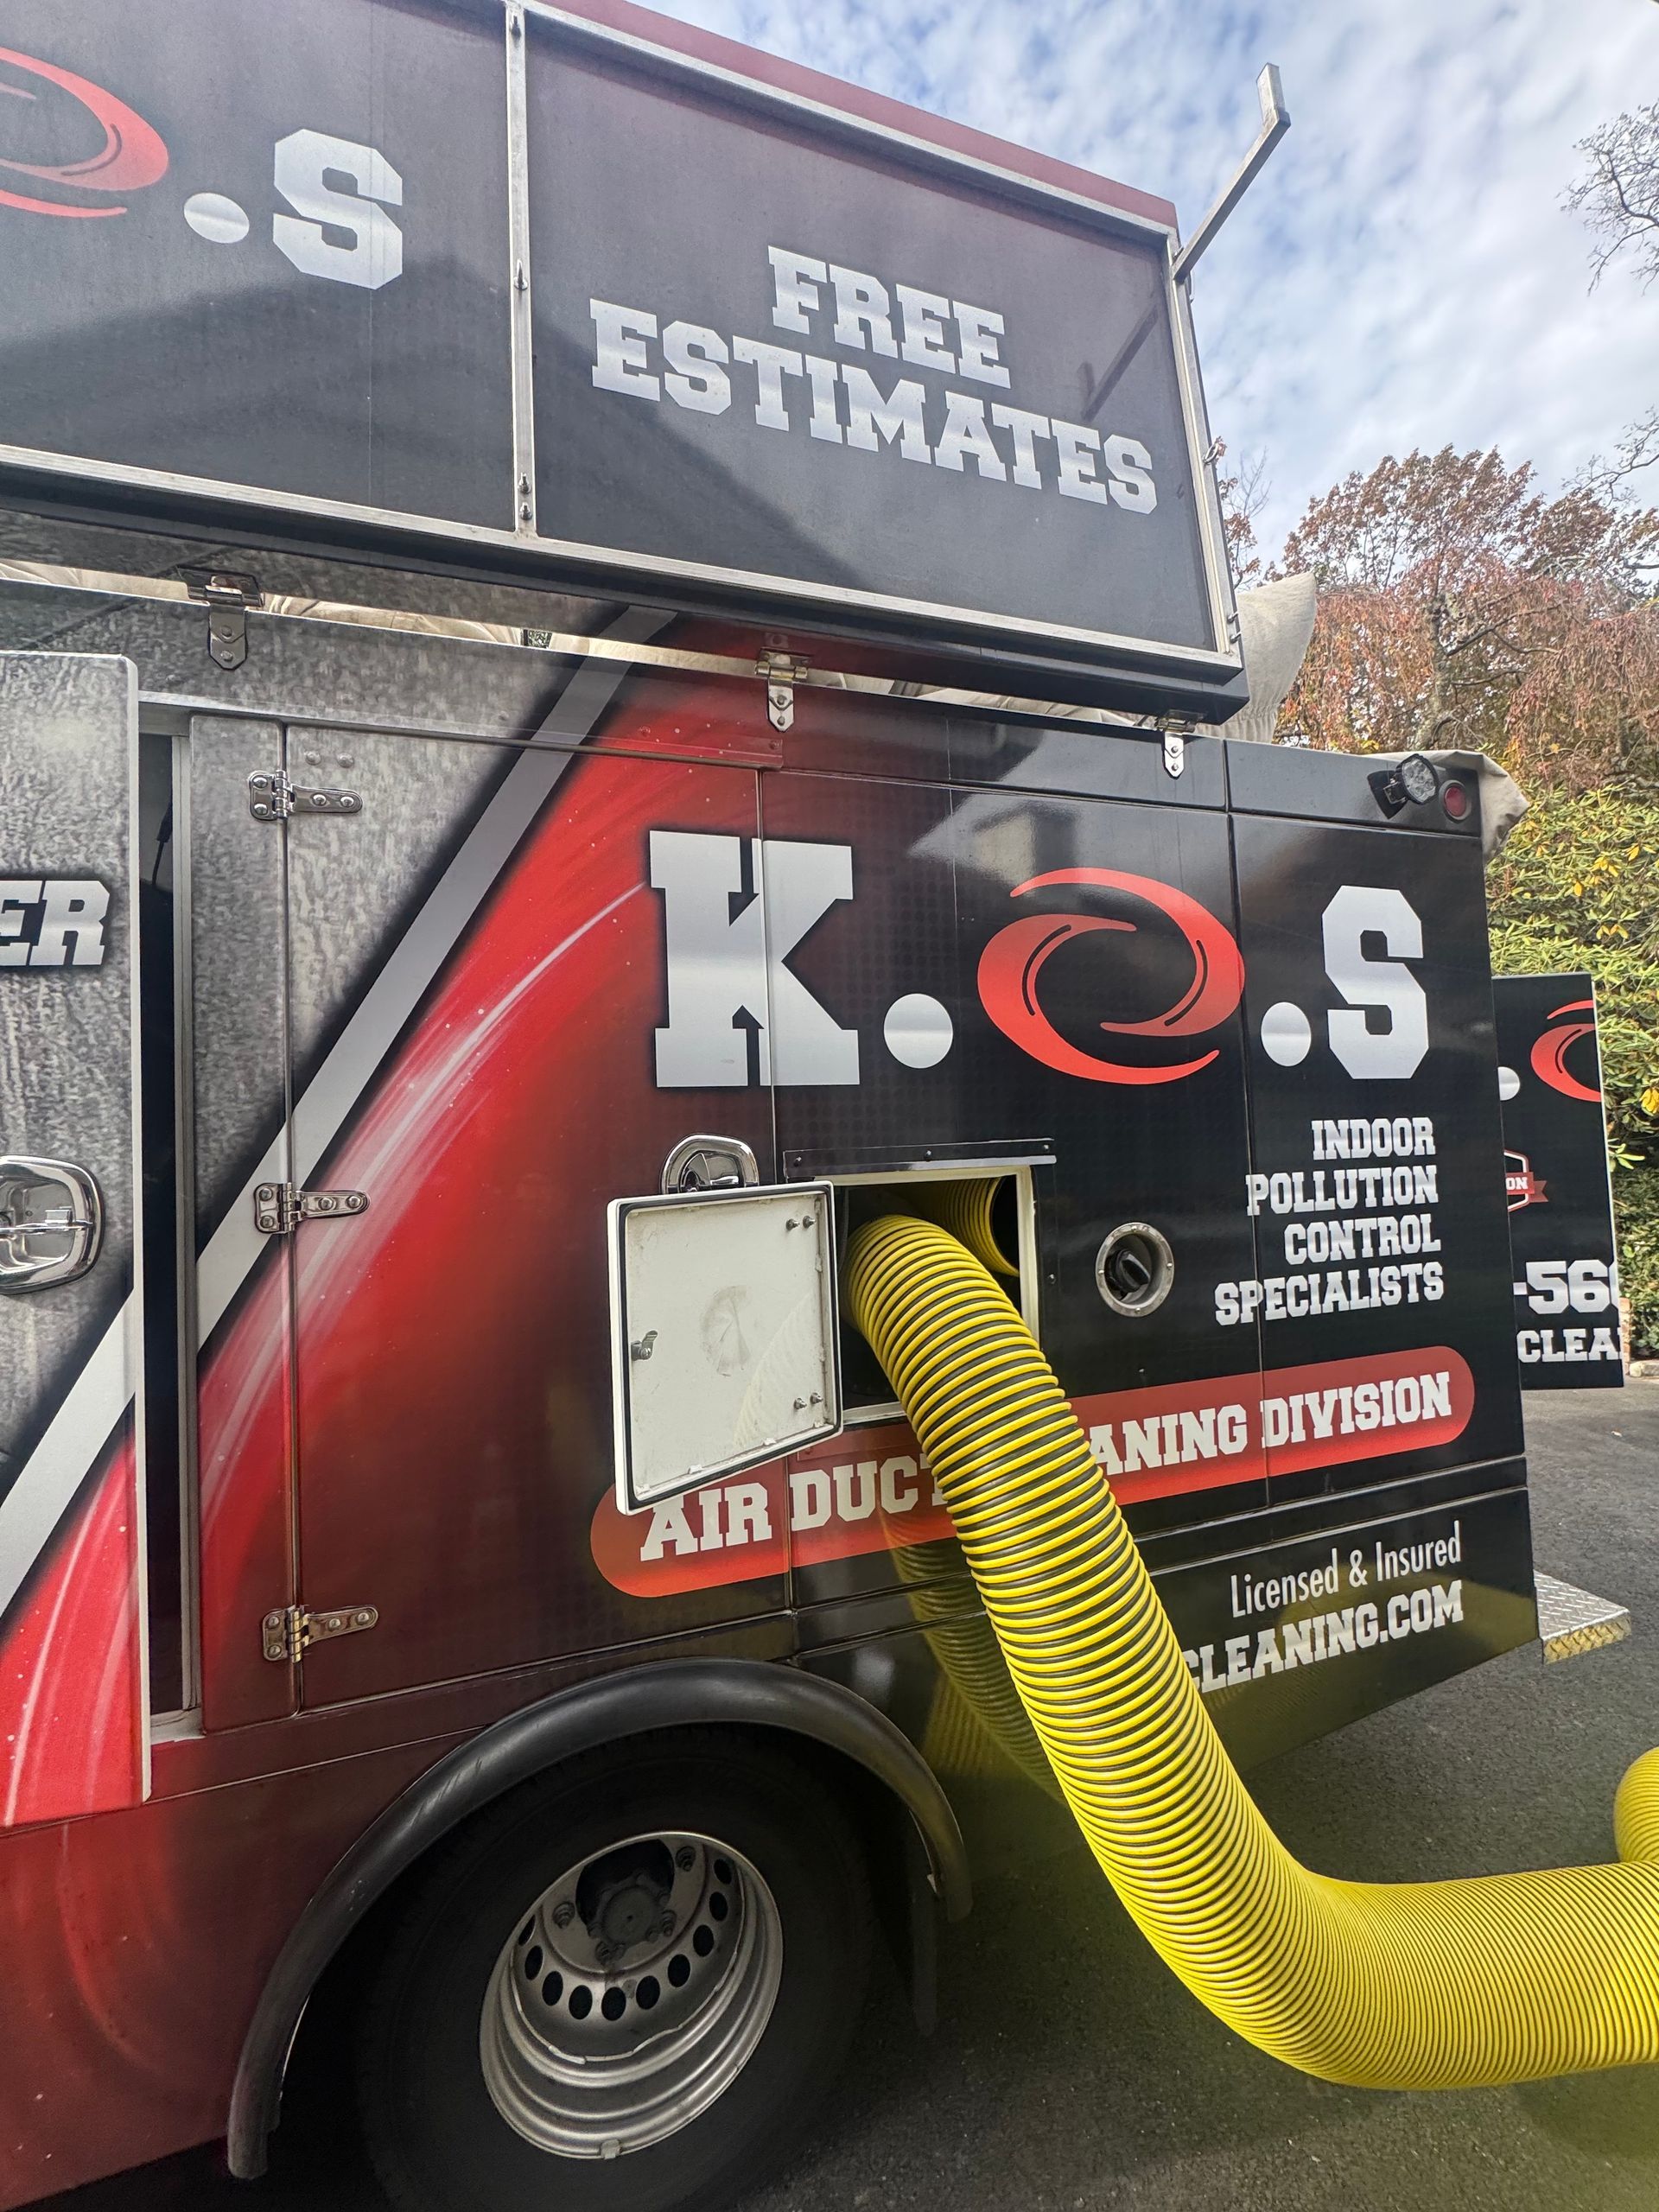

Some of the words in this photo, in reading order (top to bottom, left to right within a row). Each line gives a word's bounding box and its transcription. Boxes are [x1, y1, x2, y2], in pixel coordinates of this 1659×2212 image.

[768, 245, 1010, 389] FREE
[590, 299, 1158, 514] ESTIMATES
[1312, 1117, 1436, 1160] INDOOR
[1246, 1166, 1438, 1216] POLLUTION
[1284, 1214, 1441, 1265] CONTROL
[1214, 1262, 1444, 1325] SPECIALISTS
[1513, 1260, 1619, 1314] -56
[1516, 1327, 1623, 1363] CLEA
[640, 1483, 772, 1561] AIR
[1260, 1371, 1452, 1448] DIVISION
[1231, 1548, 1338, 1618] Licensed
[1349, 1549, 1368, 1588] &
[1376, 1520, 1462, 1581] Insured
